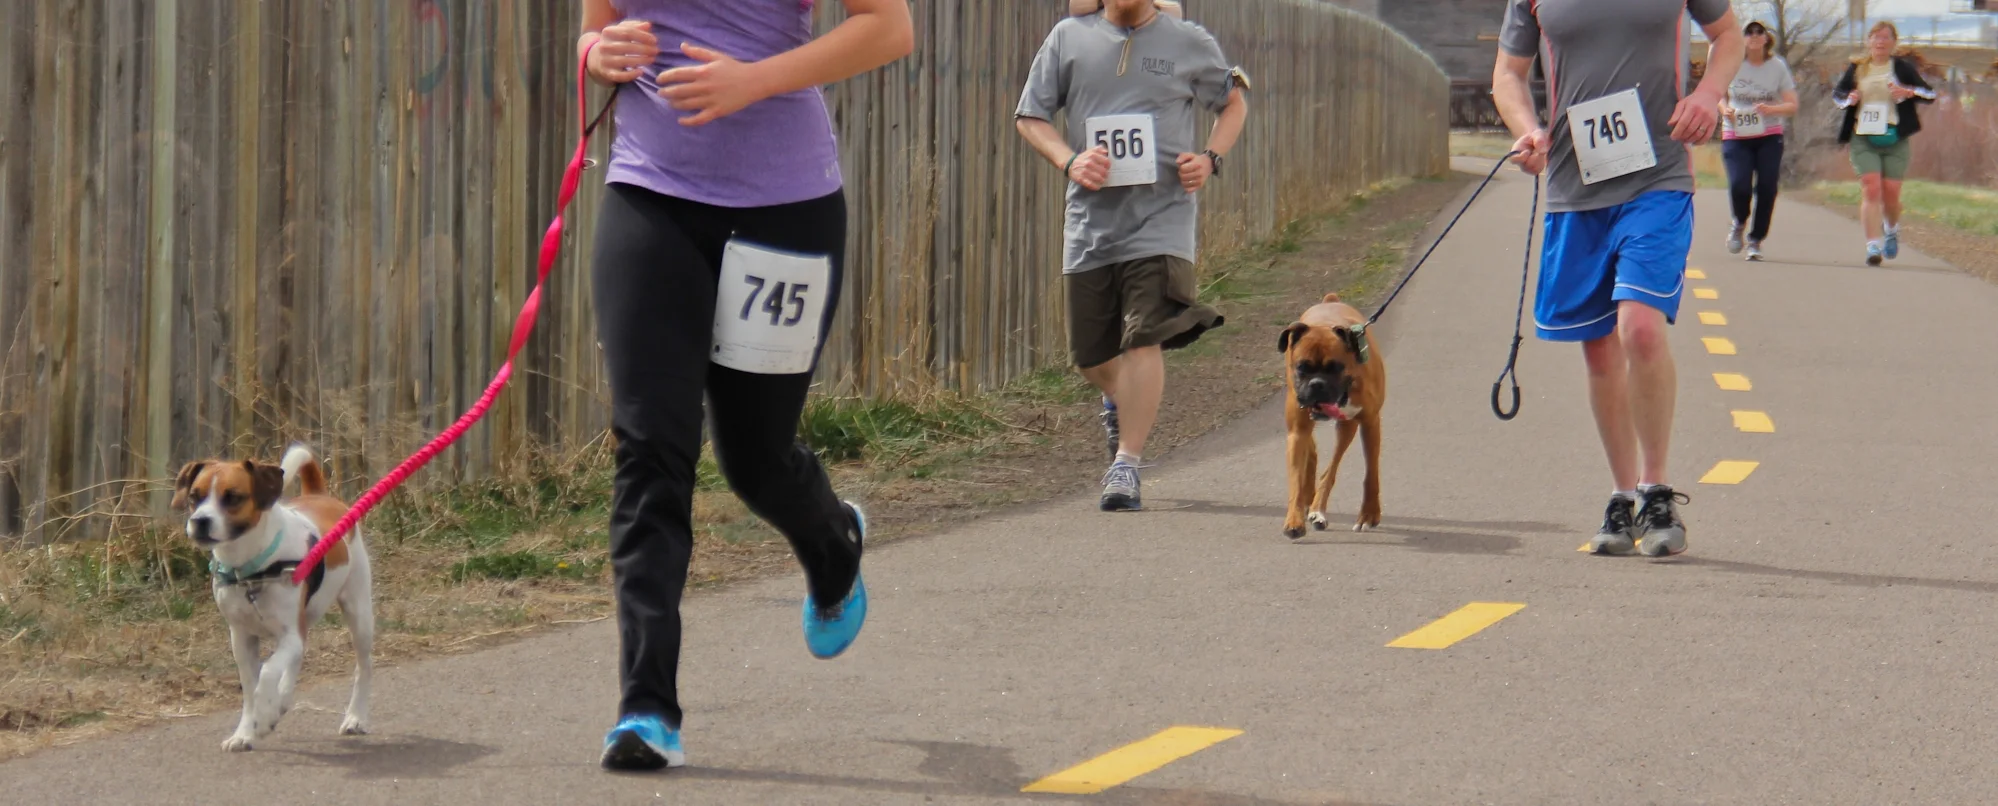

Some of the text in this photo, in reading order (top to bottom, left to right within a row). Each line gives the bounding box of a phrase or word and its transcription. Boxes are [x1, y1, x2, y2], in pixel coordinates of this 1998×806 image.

[1583, 111, 1628, 149] 746
[1737, 113, 1759, 127] 596
[1863, 111, 1879, 122] 719
[1095, 128, 1144, 160] 566
[740, 274, 809, 327] 745
